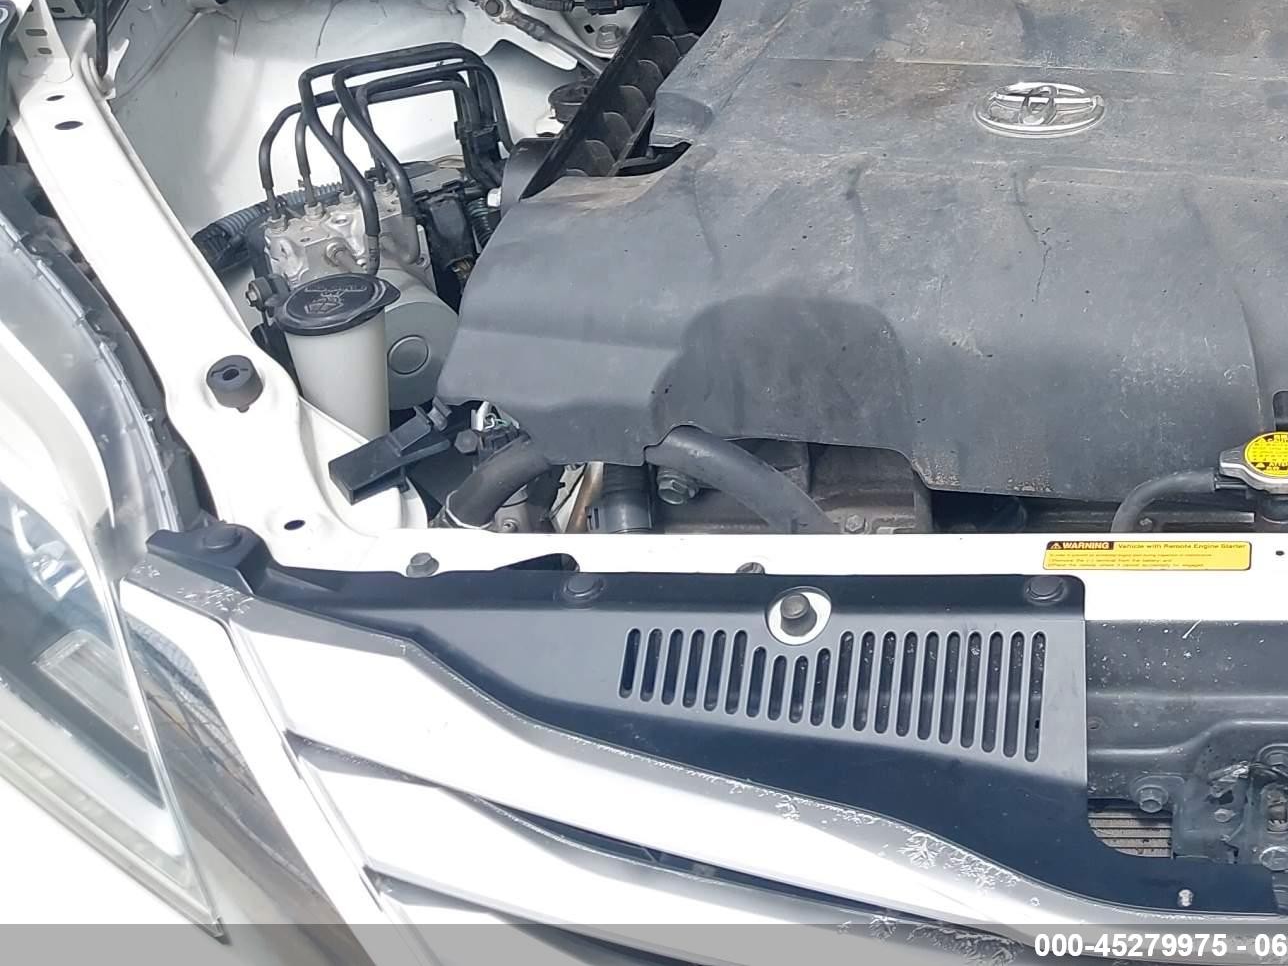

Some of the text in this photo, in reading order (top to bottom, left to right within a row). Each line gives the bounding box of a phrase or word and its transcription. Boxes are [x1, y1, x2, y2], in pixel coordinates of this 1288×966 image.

[1061, 541, 1247, 551] WARNING Vehicle with Remote Engine Starter
